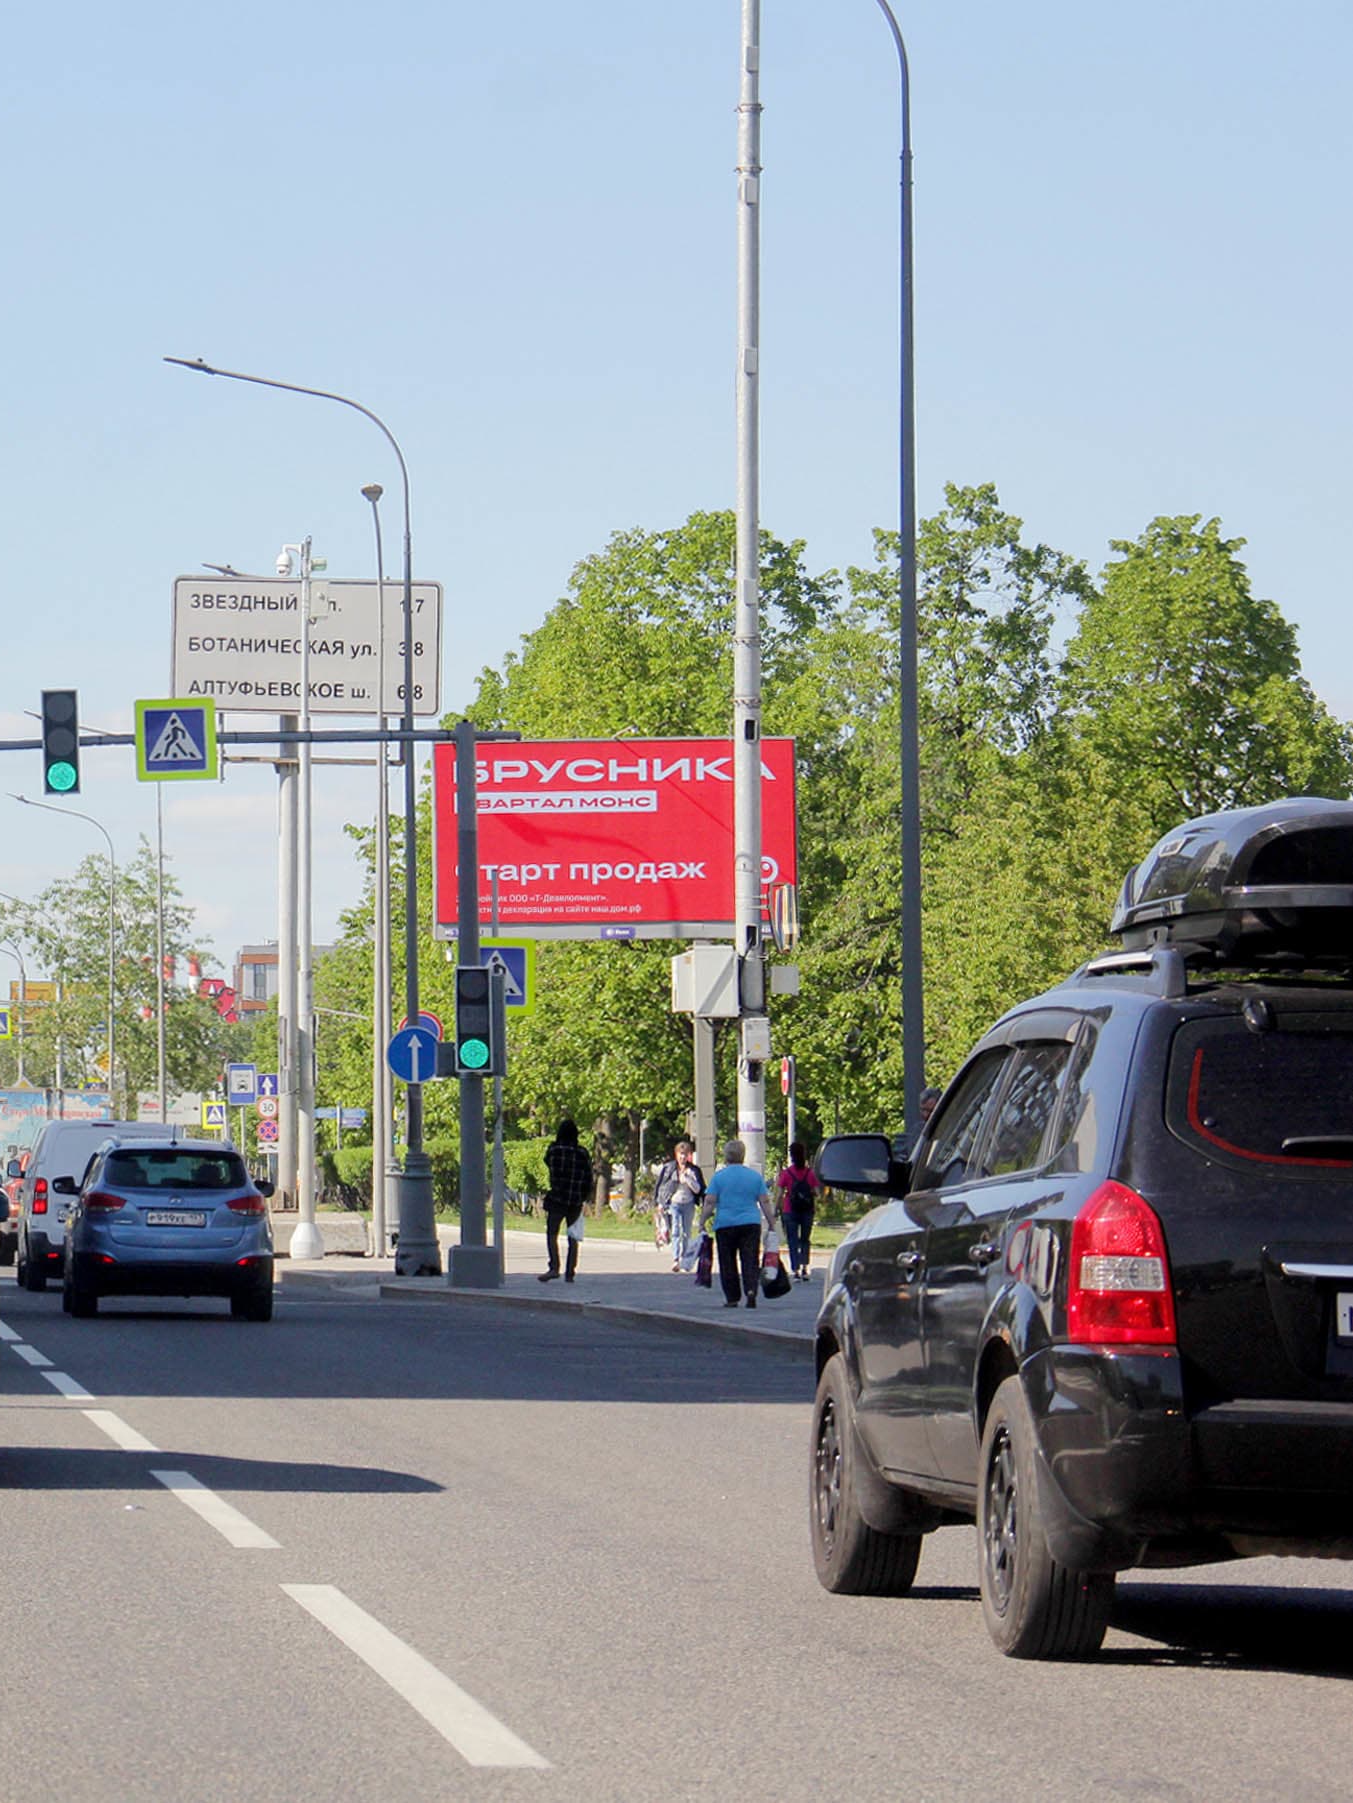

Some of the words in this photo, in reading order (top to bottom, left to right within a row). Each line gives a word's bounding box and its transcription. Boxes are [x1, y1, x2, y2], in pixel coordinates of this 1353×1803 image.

[190, 593, 298, 612] ЗВЕЗДНЫЙ
[189, 637, 344, 655] БОТАНИЧЕСКАЯ
[351, 644, 377, 659] ул.
[398, 642, 424, 656] 38
[189, 680, 344, 698] АЛТУФЬЕВСКОЕ
[351, 688, 371, 699] ш.
[397, 684, 423, 700] 68
[475, 797, 575, 809] ВАРТАЛ
[579, 797, 652, 809] МОНС
[455, 863, 561, 886] тарт
[569, 862, 707, 886] продаж
